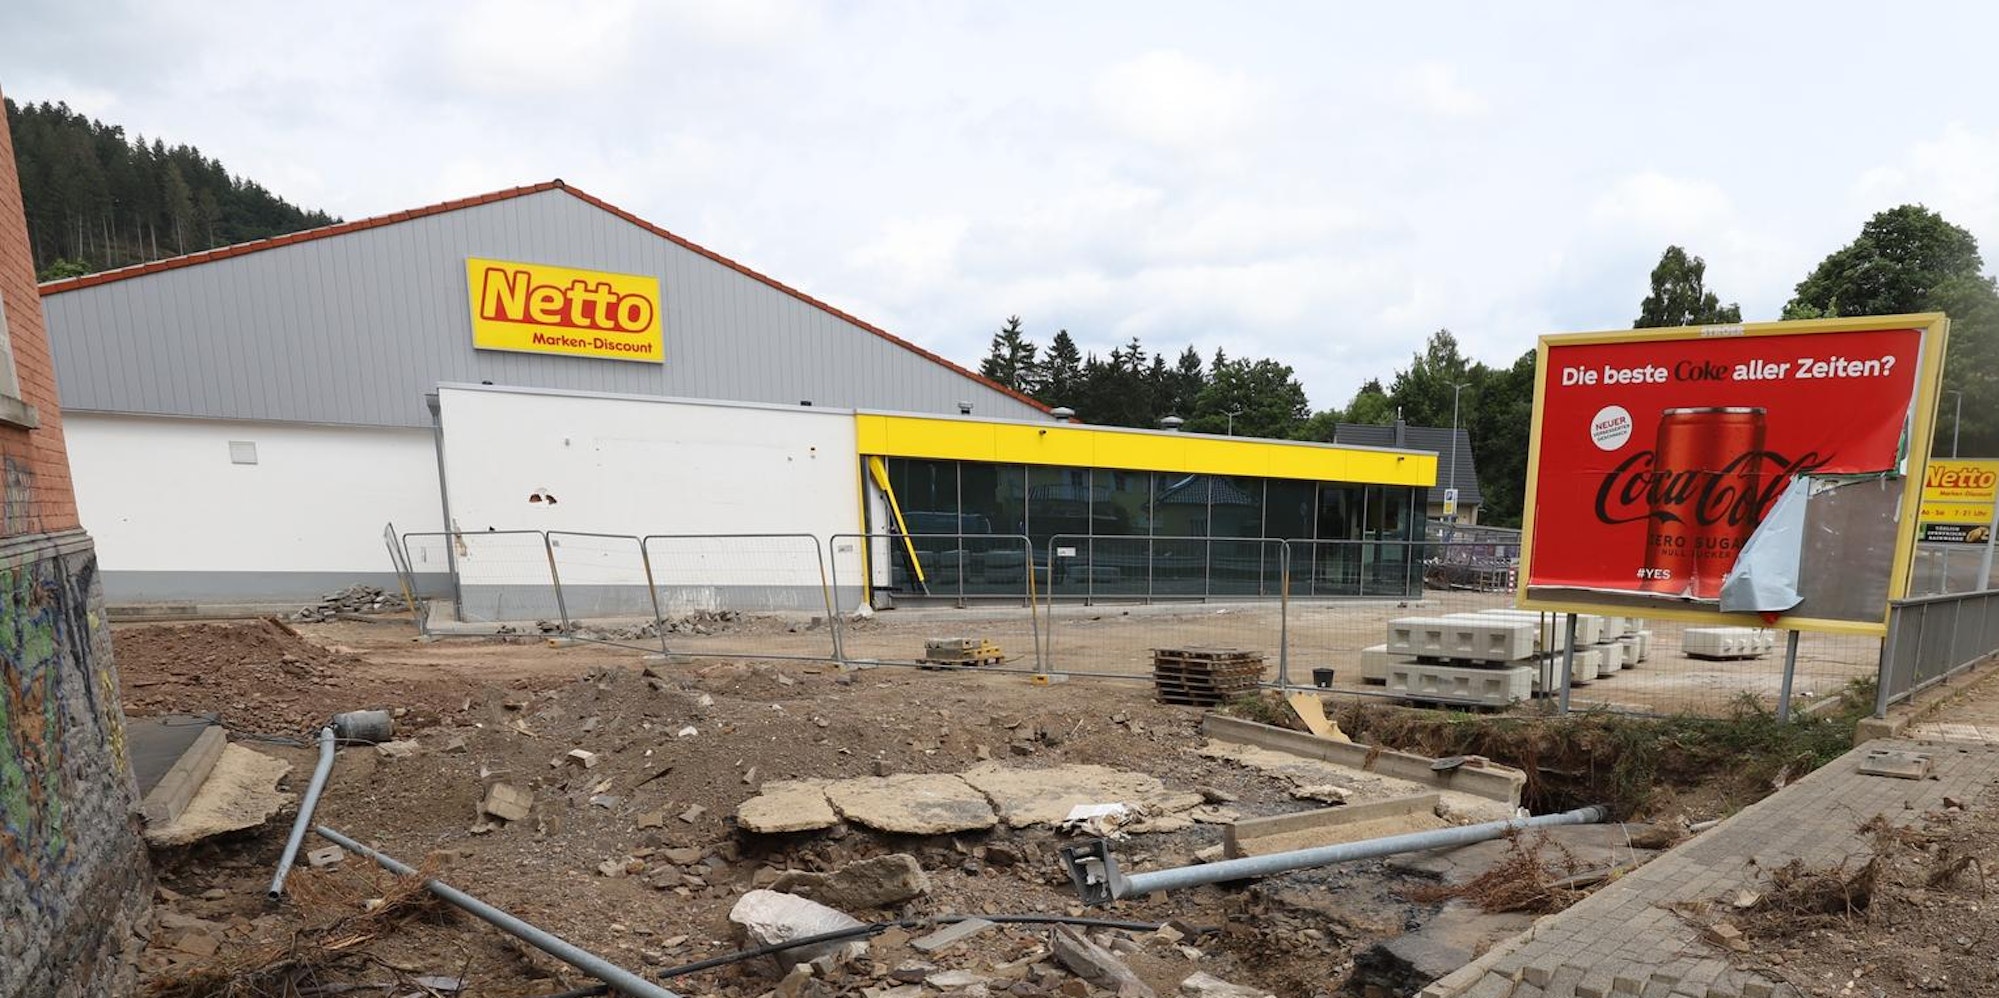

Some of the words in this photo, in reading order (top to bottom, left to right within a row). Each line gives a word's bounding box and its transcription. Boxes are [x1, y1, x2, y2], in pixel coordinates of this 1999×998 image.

[480, 267, 654, 334] Netto
[532, 332, 653, 354] Marken-Discount
[1562, 367, 1598, 386] Die
[1603, 364, 1668, 385] beste
[1674, 359, 1728, 382] Coke
[1731, 359, 1791, 381] aller
[1795, 355, 1896, 380] Zeiten?
[1595, 416, 1627, 431] NEUER
[1926, 465, 1996, 488] Netto
[1694, 536, 1742, 550] SUGA
[1661, 547, 1685, 558] NULL
[1636, 567, 1672, 580] #YES
